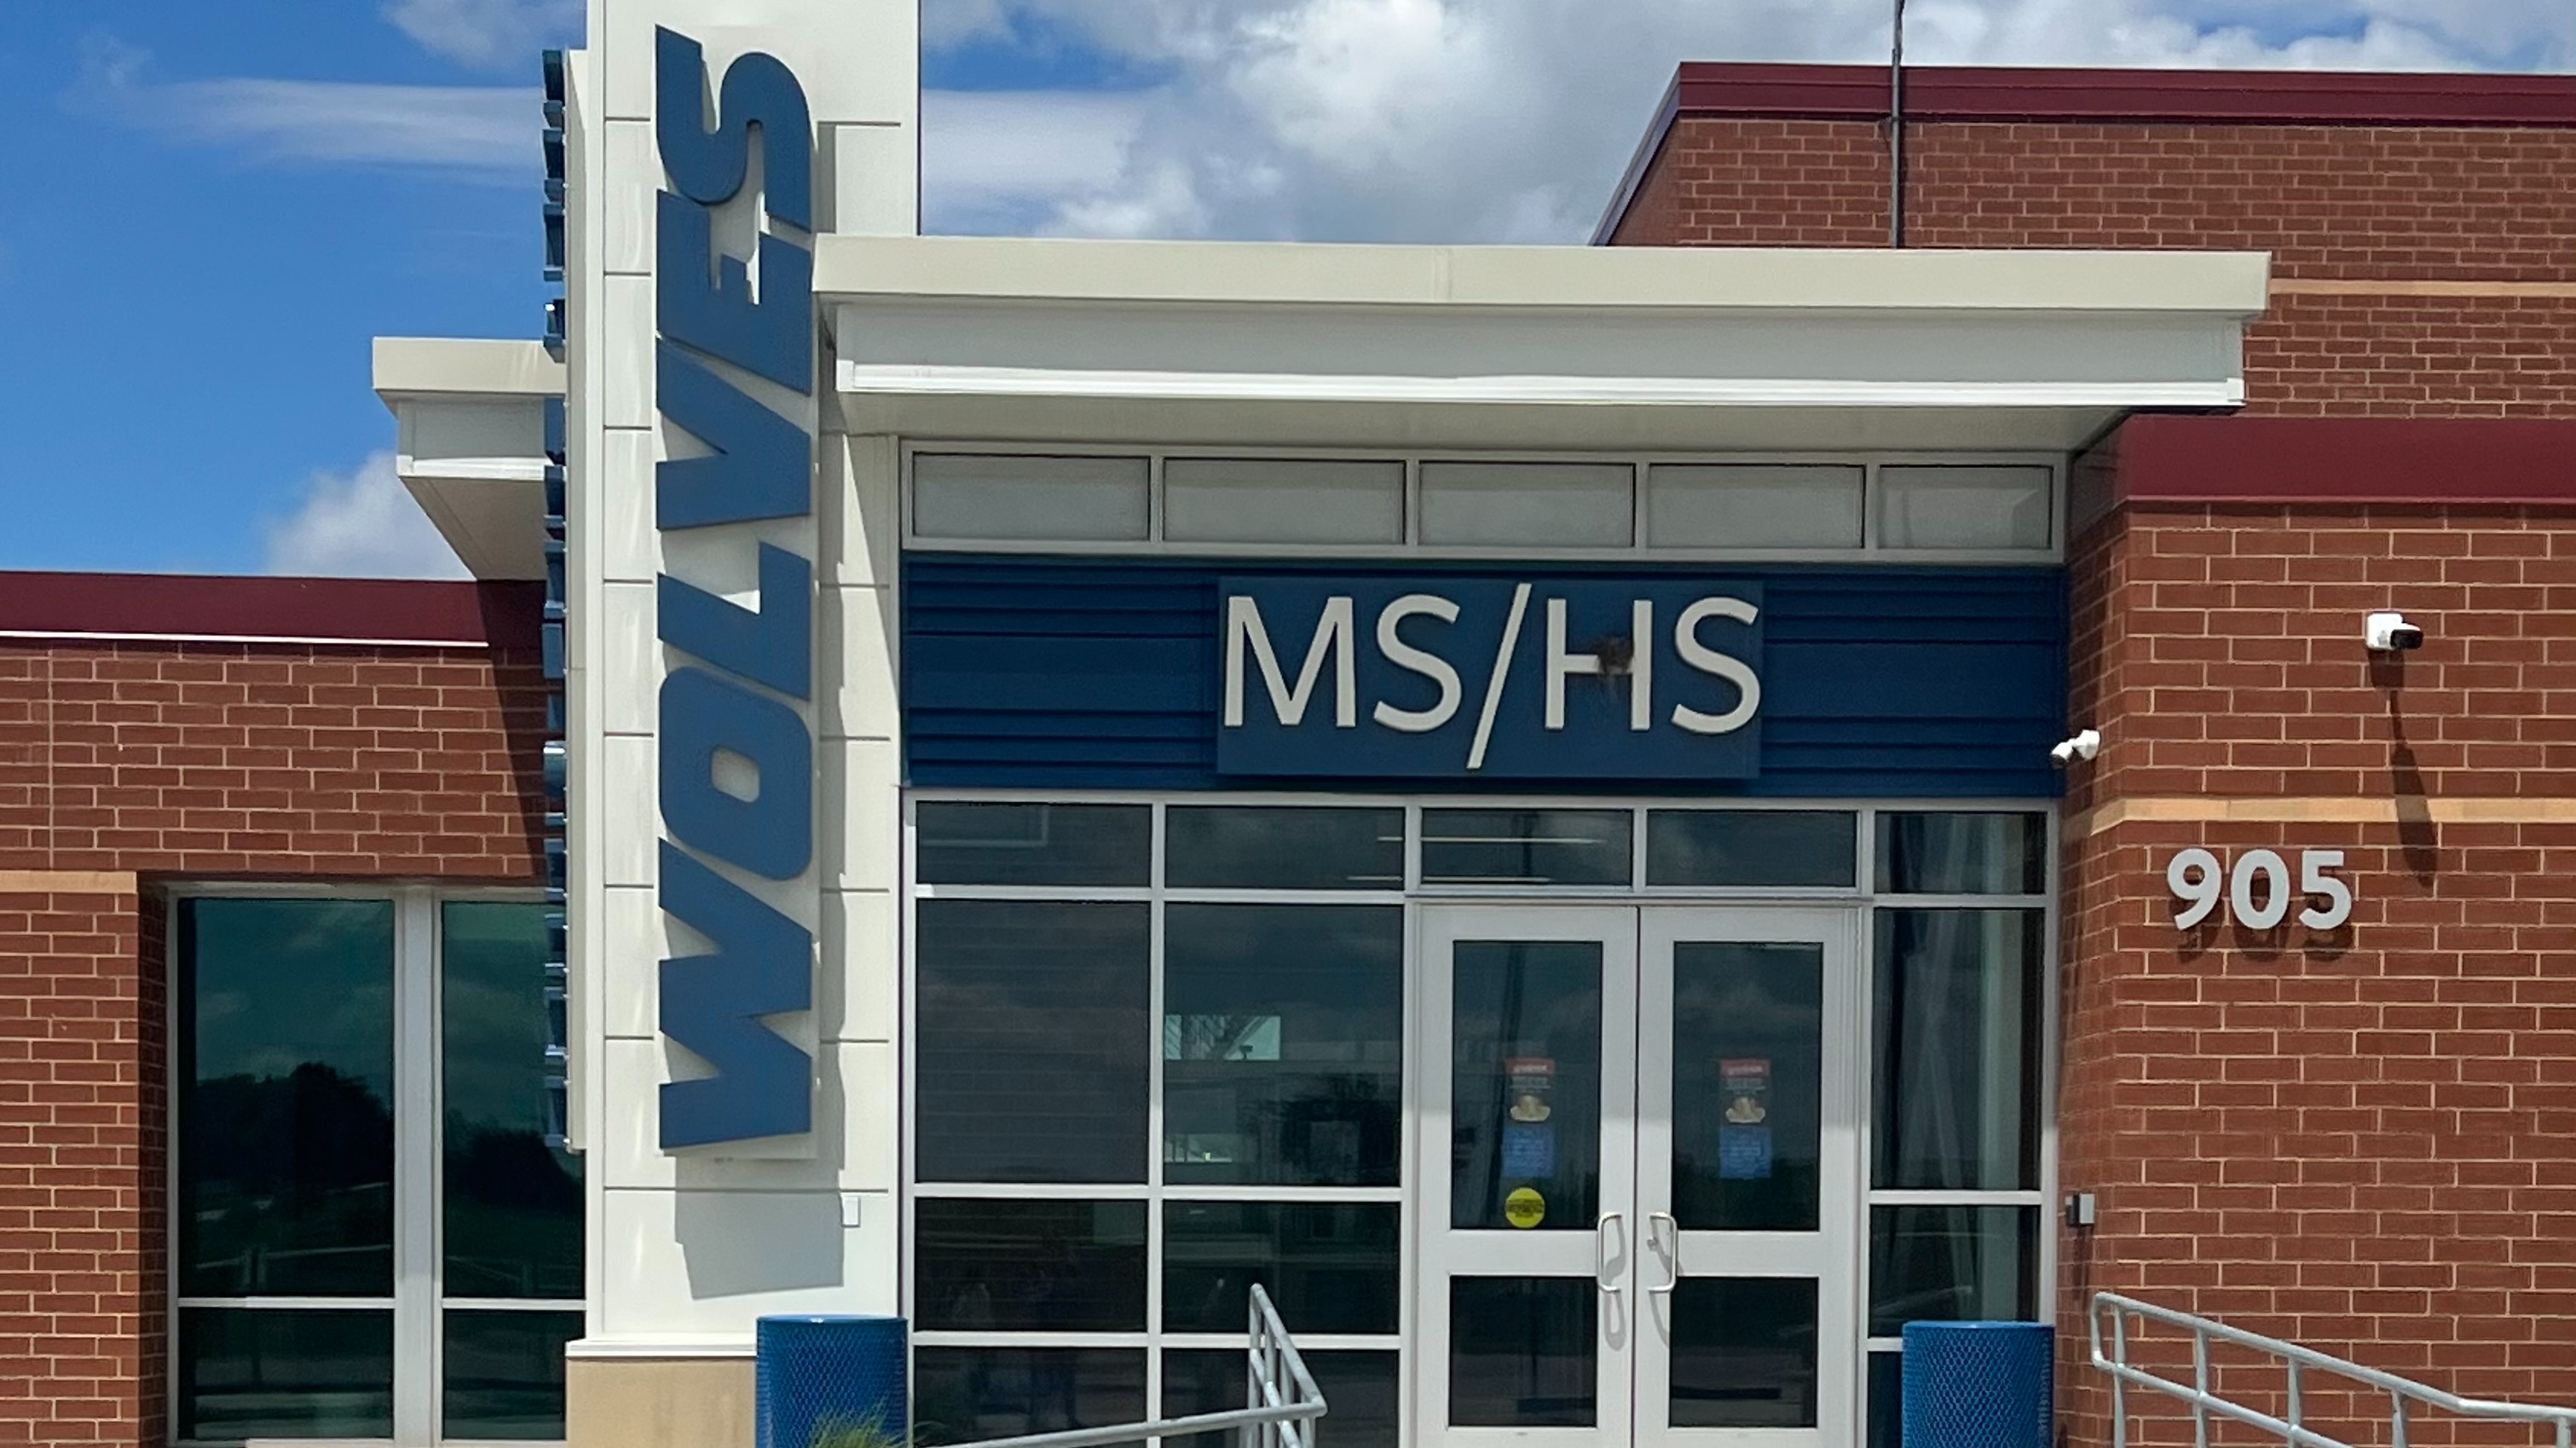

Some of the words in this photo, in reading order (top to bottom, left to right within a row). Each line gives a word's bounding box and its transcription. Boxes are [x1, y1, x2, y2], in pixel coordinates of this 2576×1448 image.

[656, 24, 812, 1149] WOLVES
[1224, 582, 1761, 769] MS/HS
[2167, 848, 2352, 931] 905
